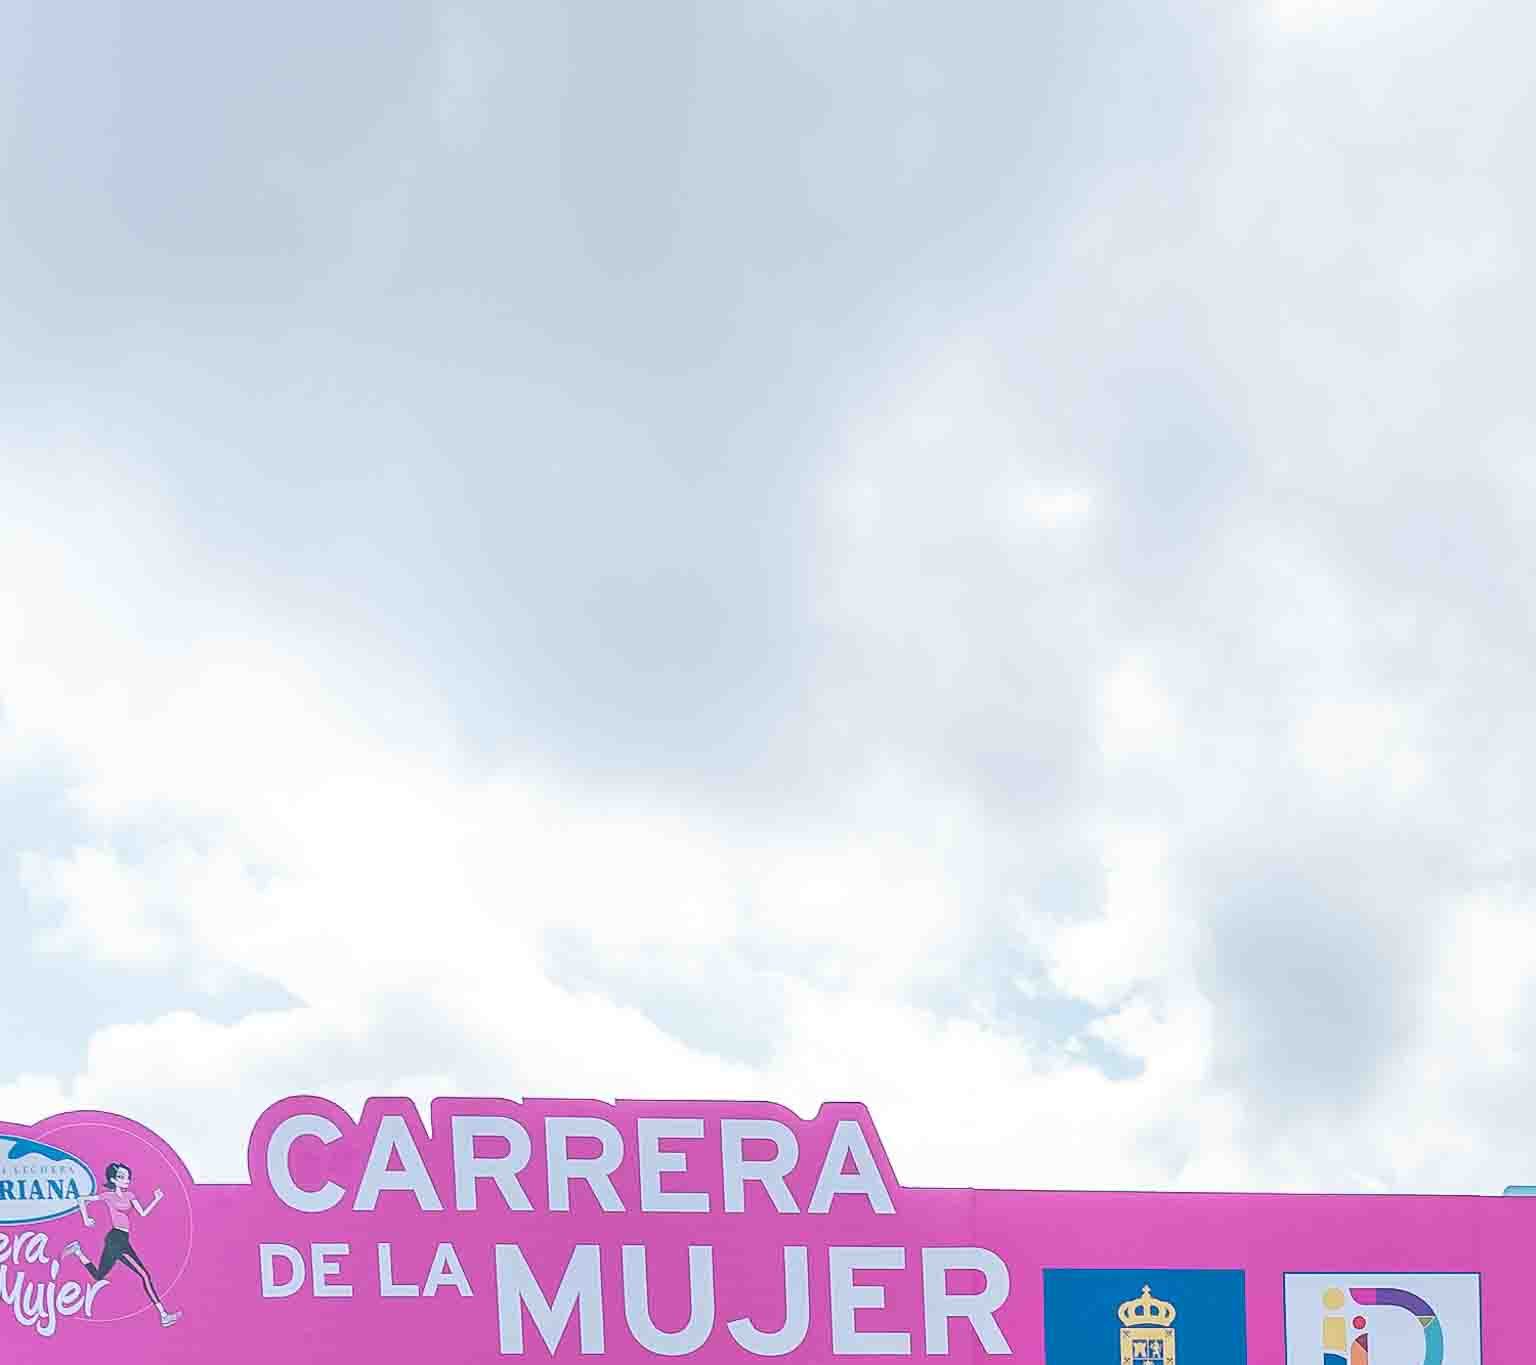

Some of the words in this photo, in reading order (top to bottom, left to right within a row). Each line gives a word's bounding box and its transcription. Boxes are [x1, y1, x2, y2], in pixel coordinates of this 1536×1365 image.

[266, 1113, 898, 1214] CARRERA
[260, 1241, 353, 1298] DE
[380, 1241, 474, 1297] LA
[495, 1243, 1013, 1358] MUJER
